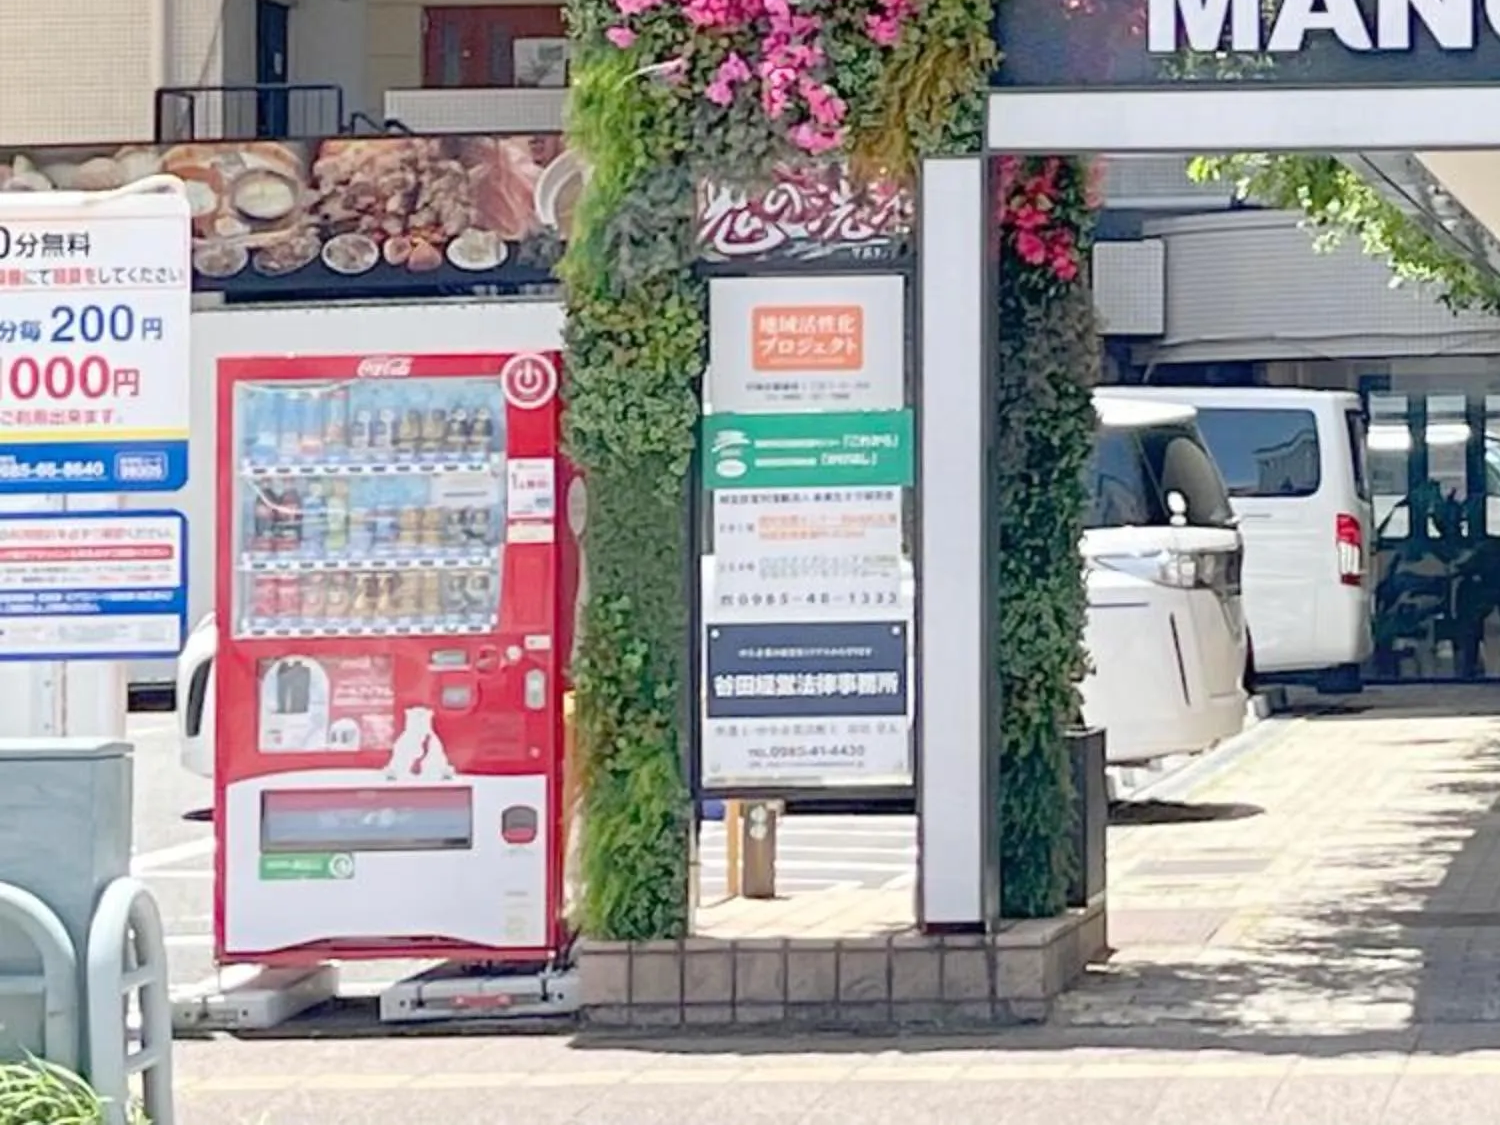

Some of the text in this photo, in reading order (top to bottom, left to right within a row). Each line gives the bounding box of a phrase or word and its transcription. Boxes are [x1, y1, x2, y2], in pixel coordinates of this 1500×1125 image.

[759, 335, 858, 356] プロジェクト
[0, 356, 140, 400] 000円
